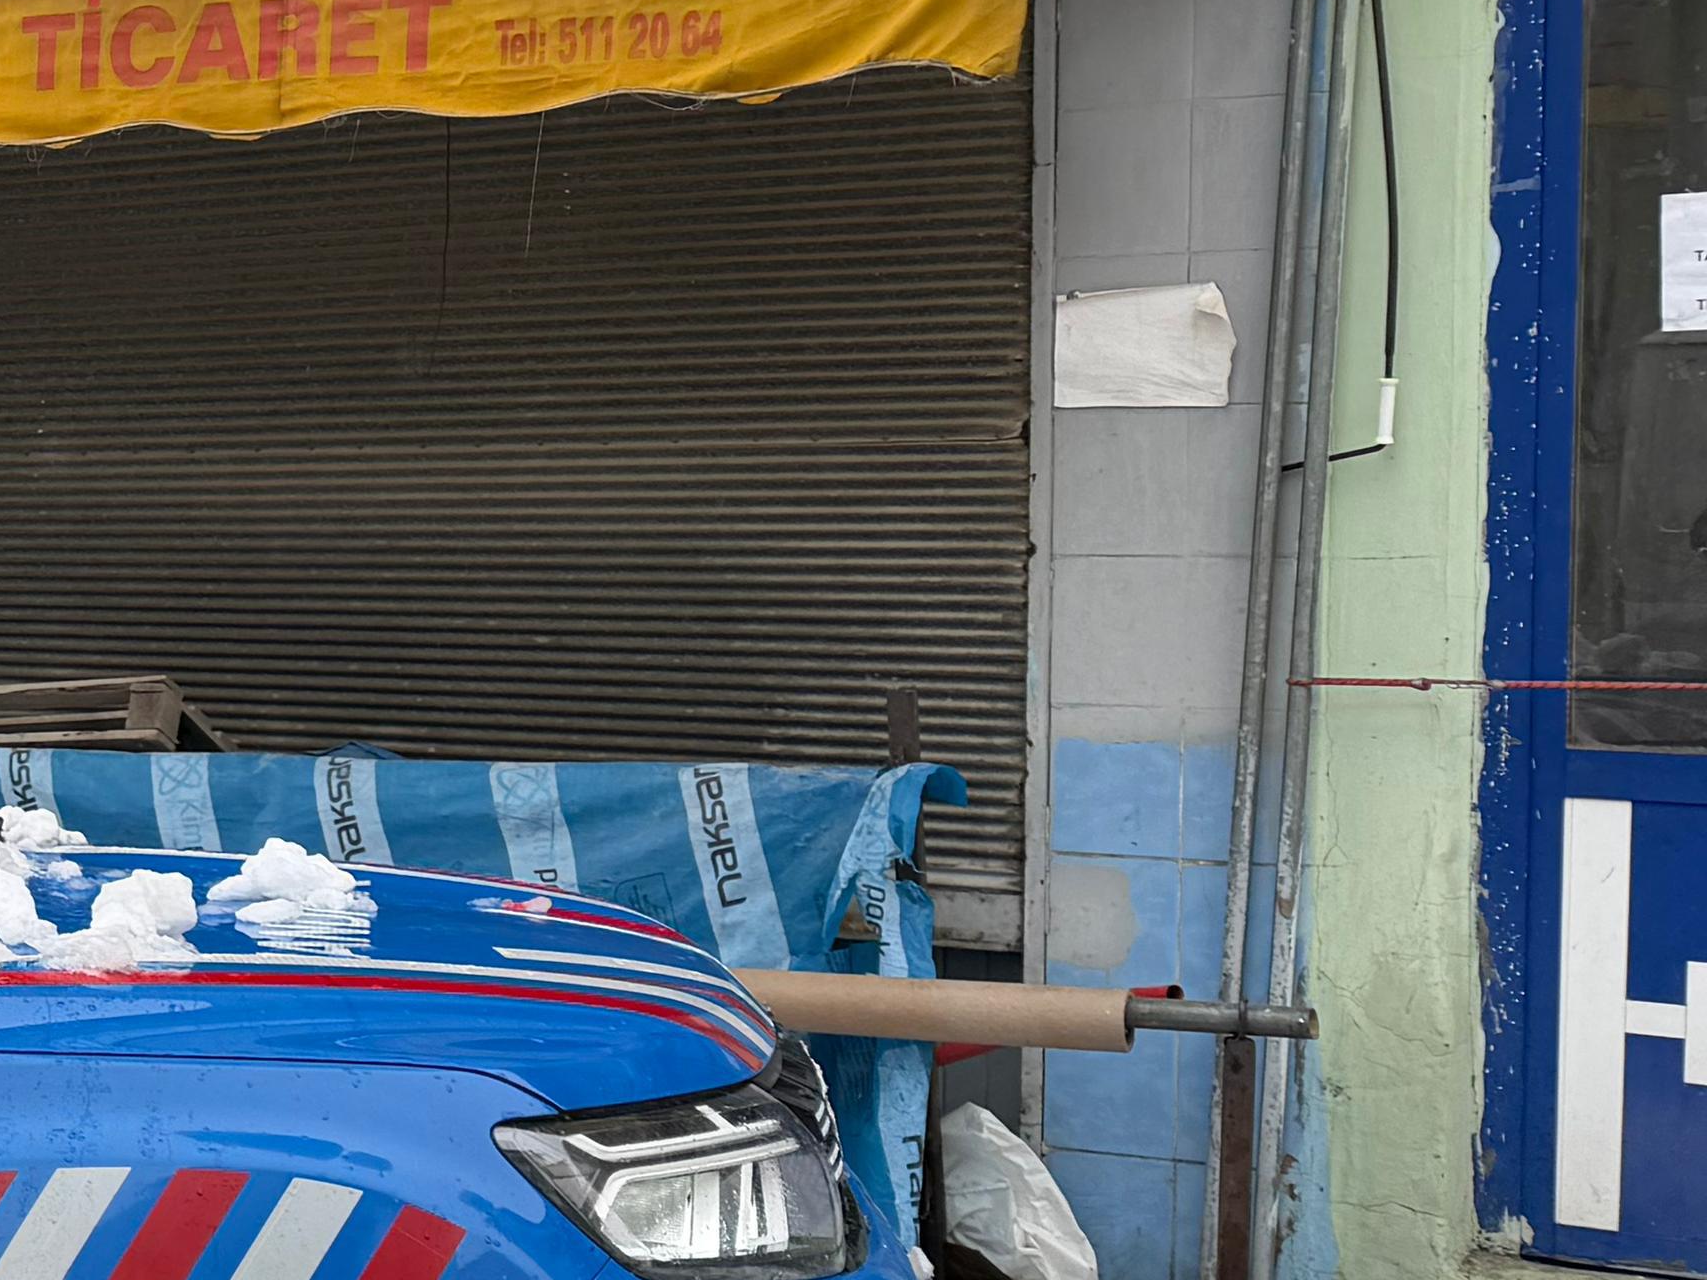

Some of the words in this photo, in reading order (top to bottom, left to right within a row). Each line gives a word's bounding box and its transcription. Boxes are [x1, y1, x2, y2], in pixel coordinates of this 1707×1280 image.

[494, 18, 548, 67] Tel:
[557, 14, 616, 67] 511
[627, 12, 669, 62] 20
[680, 8, 724, 57] 64
